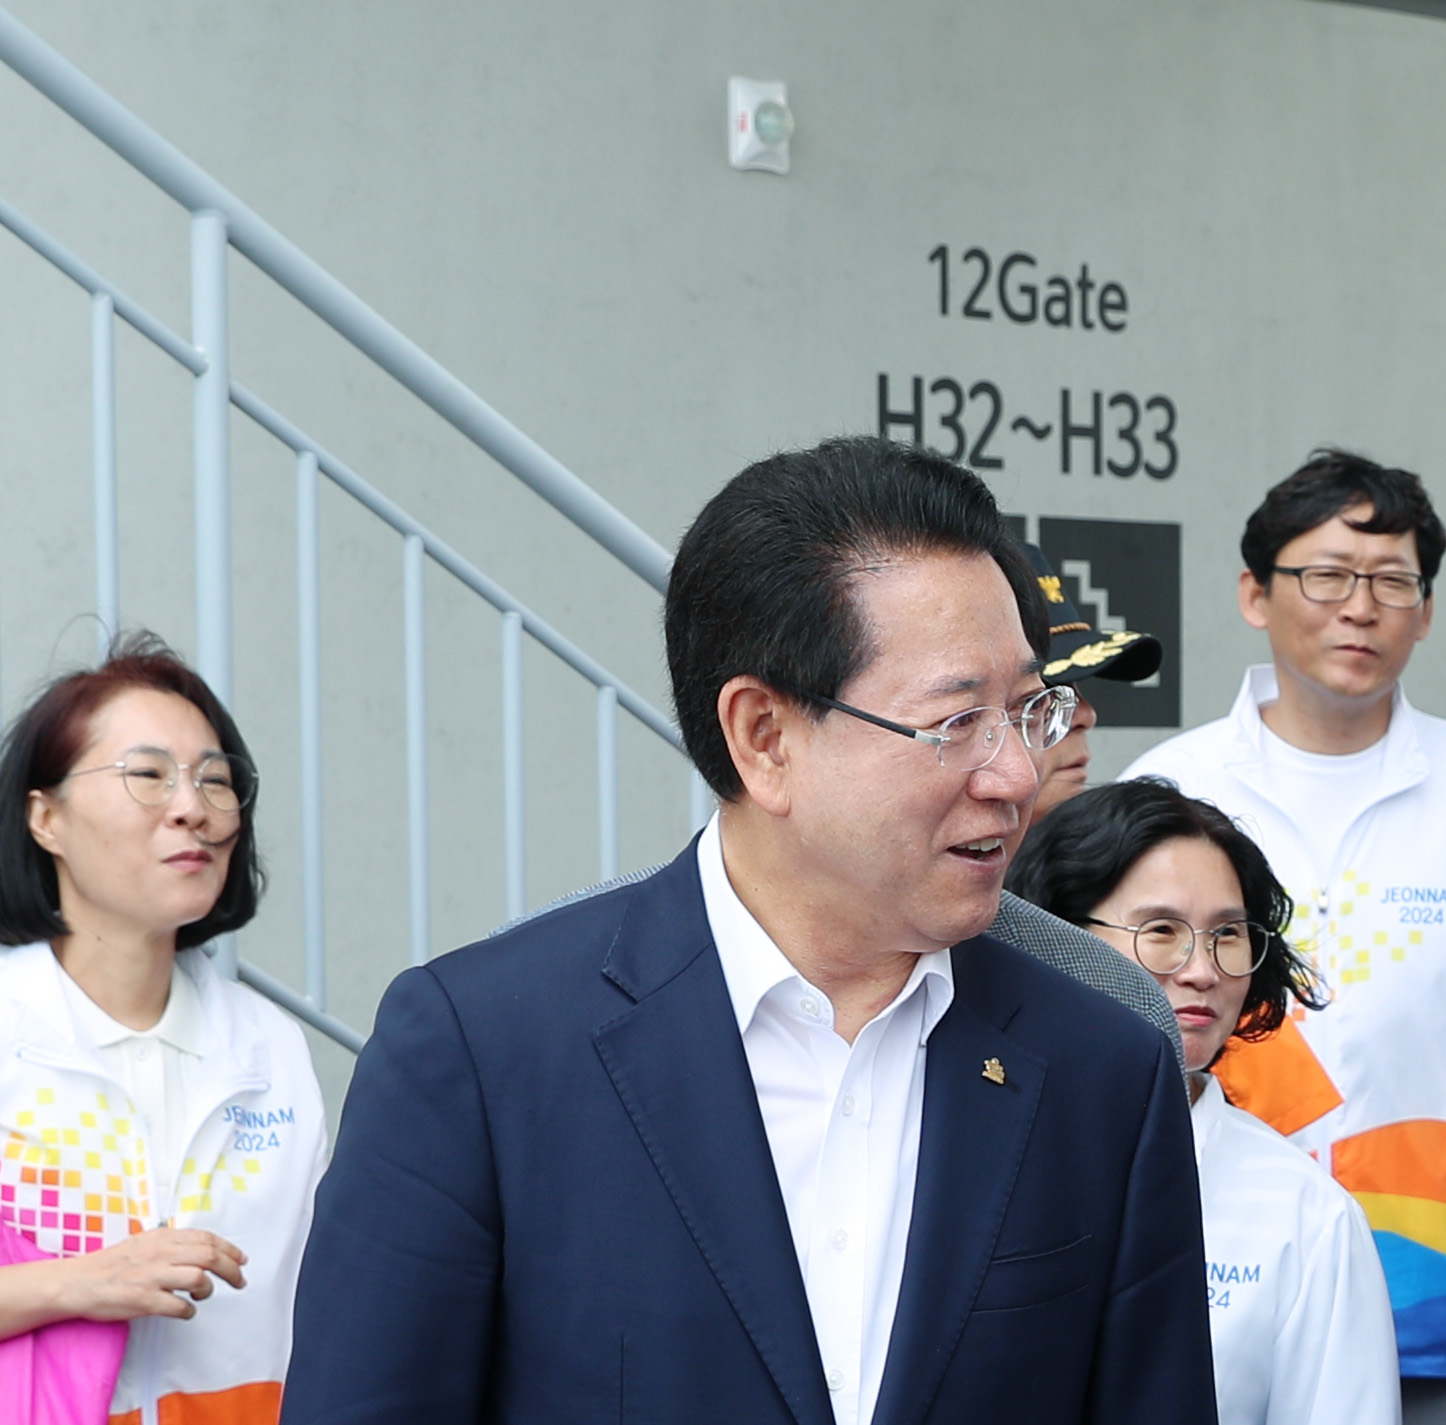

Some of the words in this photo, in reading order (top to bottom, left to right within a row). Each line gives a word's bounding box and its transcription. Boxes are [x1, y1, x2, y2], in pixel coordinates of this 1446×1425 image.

[927, 244, 1129, 333] 12Gate
[876, 372, 1180, 481] H32~H33
[1399, 906, 1444, 924] 2024
[233, 1130, 281, 1153] 2024
[1204, 1262, 1261, 1284] NAM
